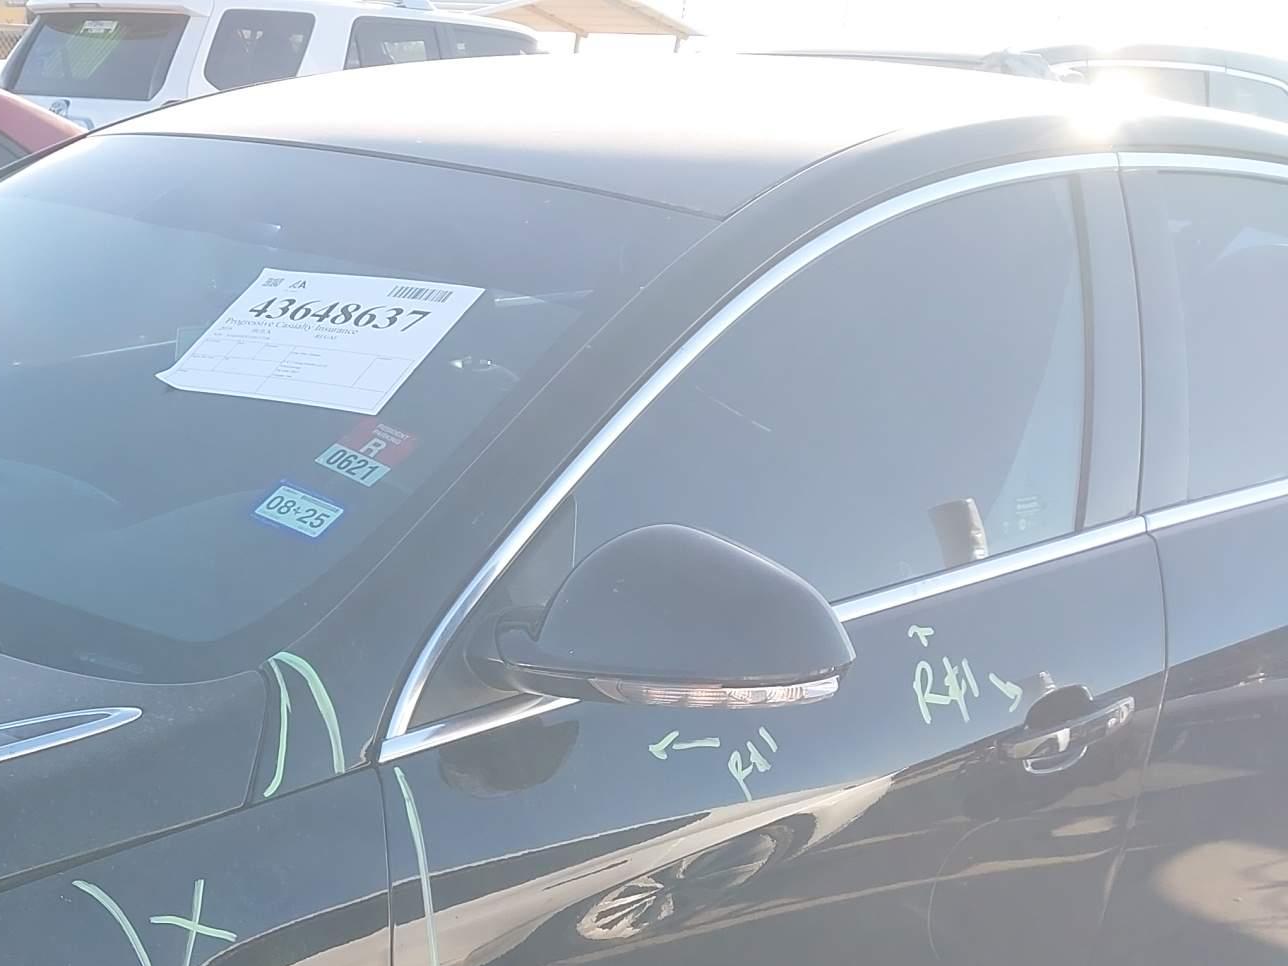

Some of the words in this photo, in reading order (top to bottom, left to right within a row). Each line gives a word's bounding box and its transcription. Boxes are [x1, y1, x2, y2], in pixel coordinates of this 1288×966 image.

[225, 317, 275, 328] Progressive
[275, 320, 312, 331] Casualty
[314, 324, 359, 335] Insurance
[249, 296, 431, 332] 43648637
[360, 438, 387, 458] R
[326, 449, 379, 481] 0621
